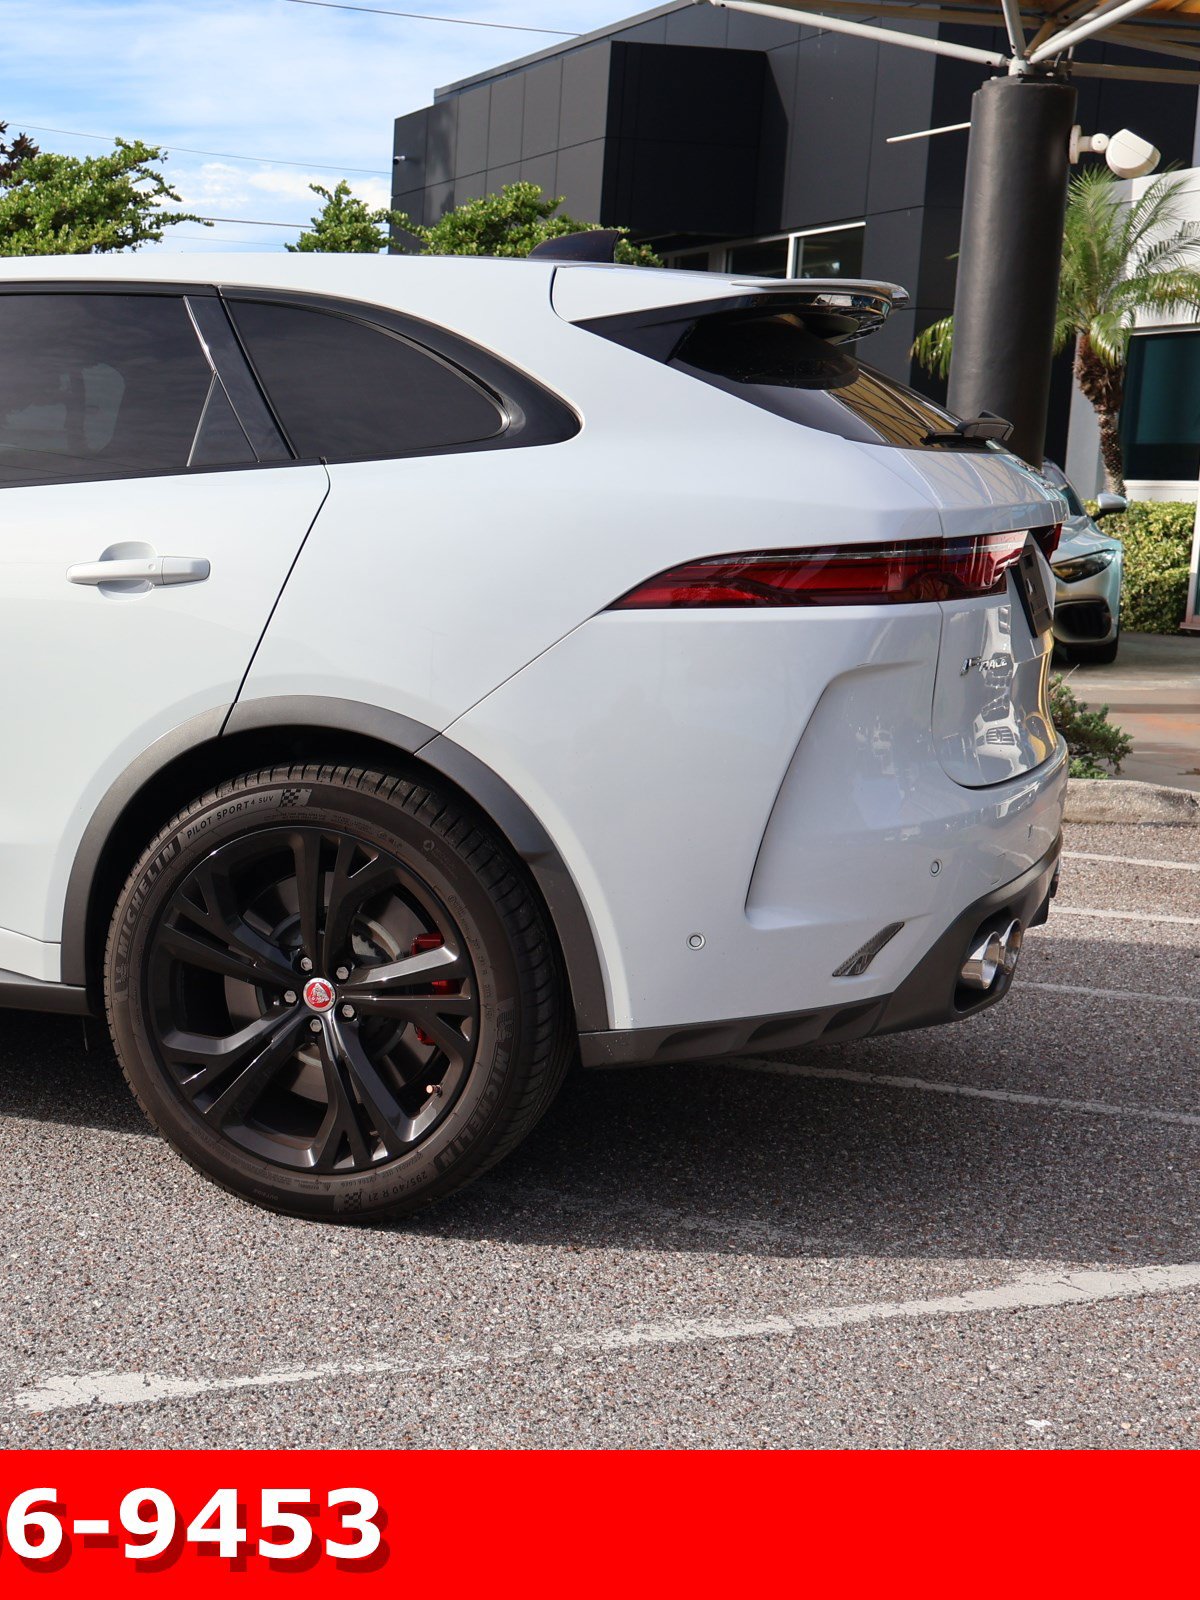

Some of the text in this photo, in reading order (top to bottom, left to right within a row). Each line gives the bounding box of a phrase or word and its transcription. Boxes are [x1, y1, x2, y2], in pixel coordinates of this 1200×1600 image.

[186, 816, 212, 839] PILOT
[216, 801, 250, 820] SPORT
[258, 795, 274, 804] SUV
[117, 843, 179, 959] MICHELIN
[435, 1047, 511, 1172] MICHELIN
[368, 1170, 428, 1202] 295/40 R 21
